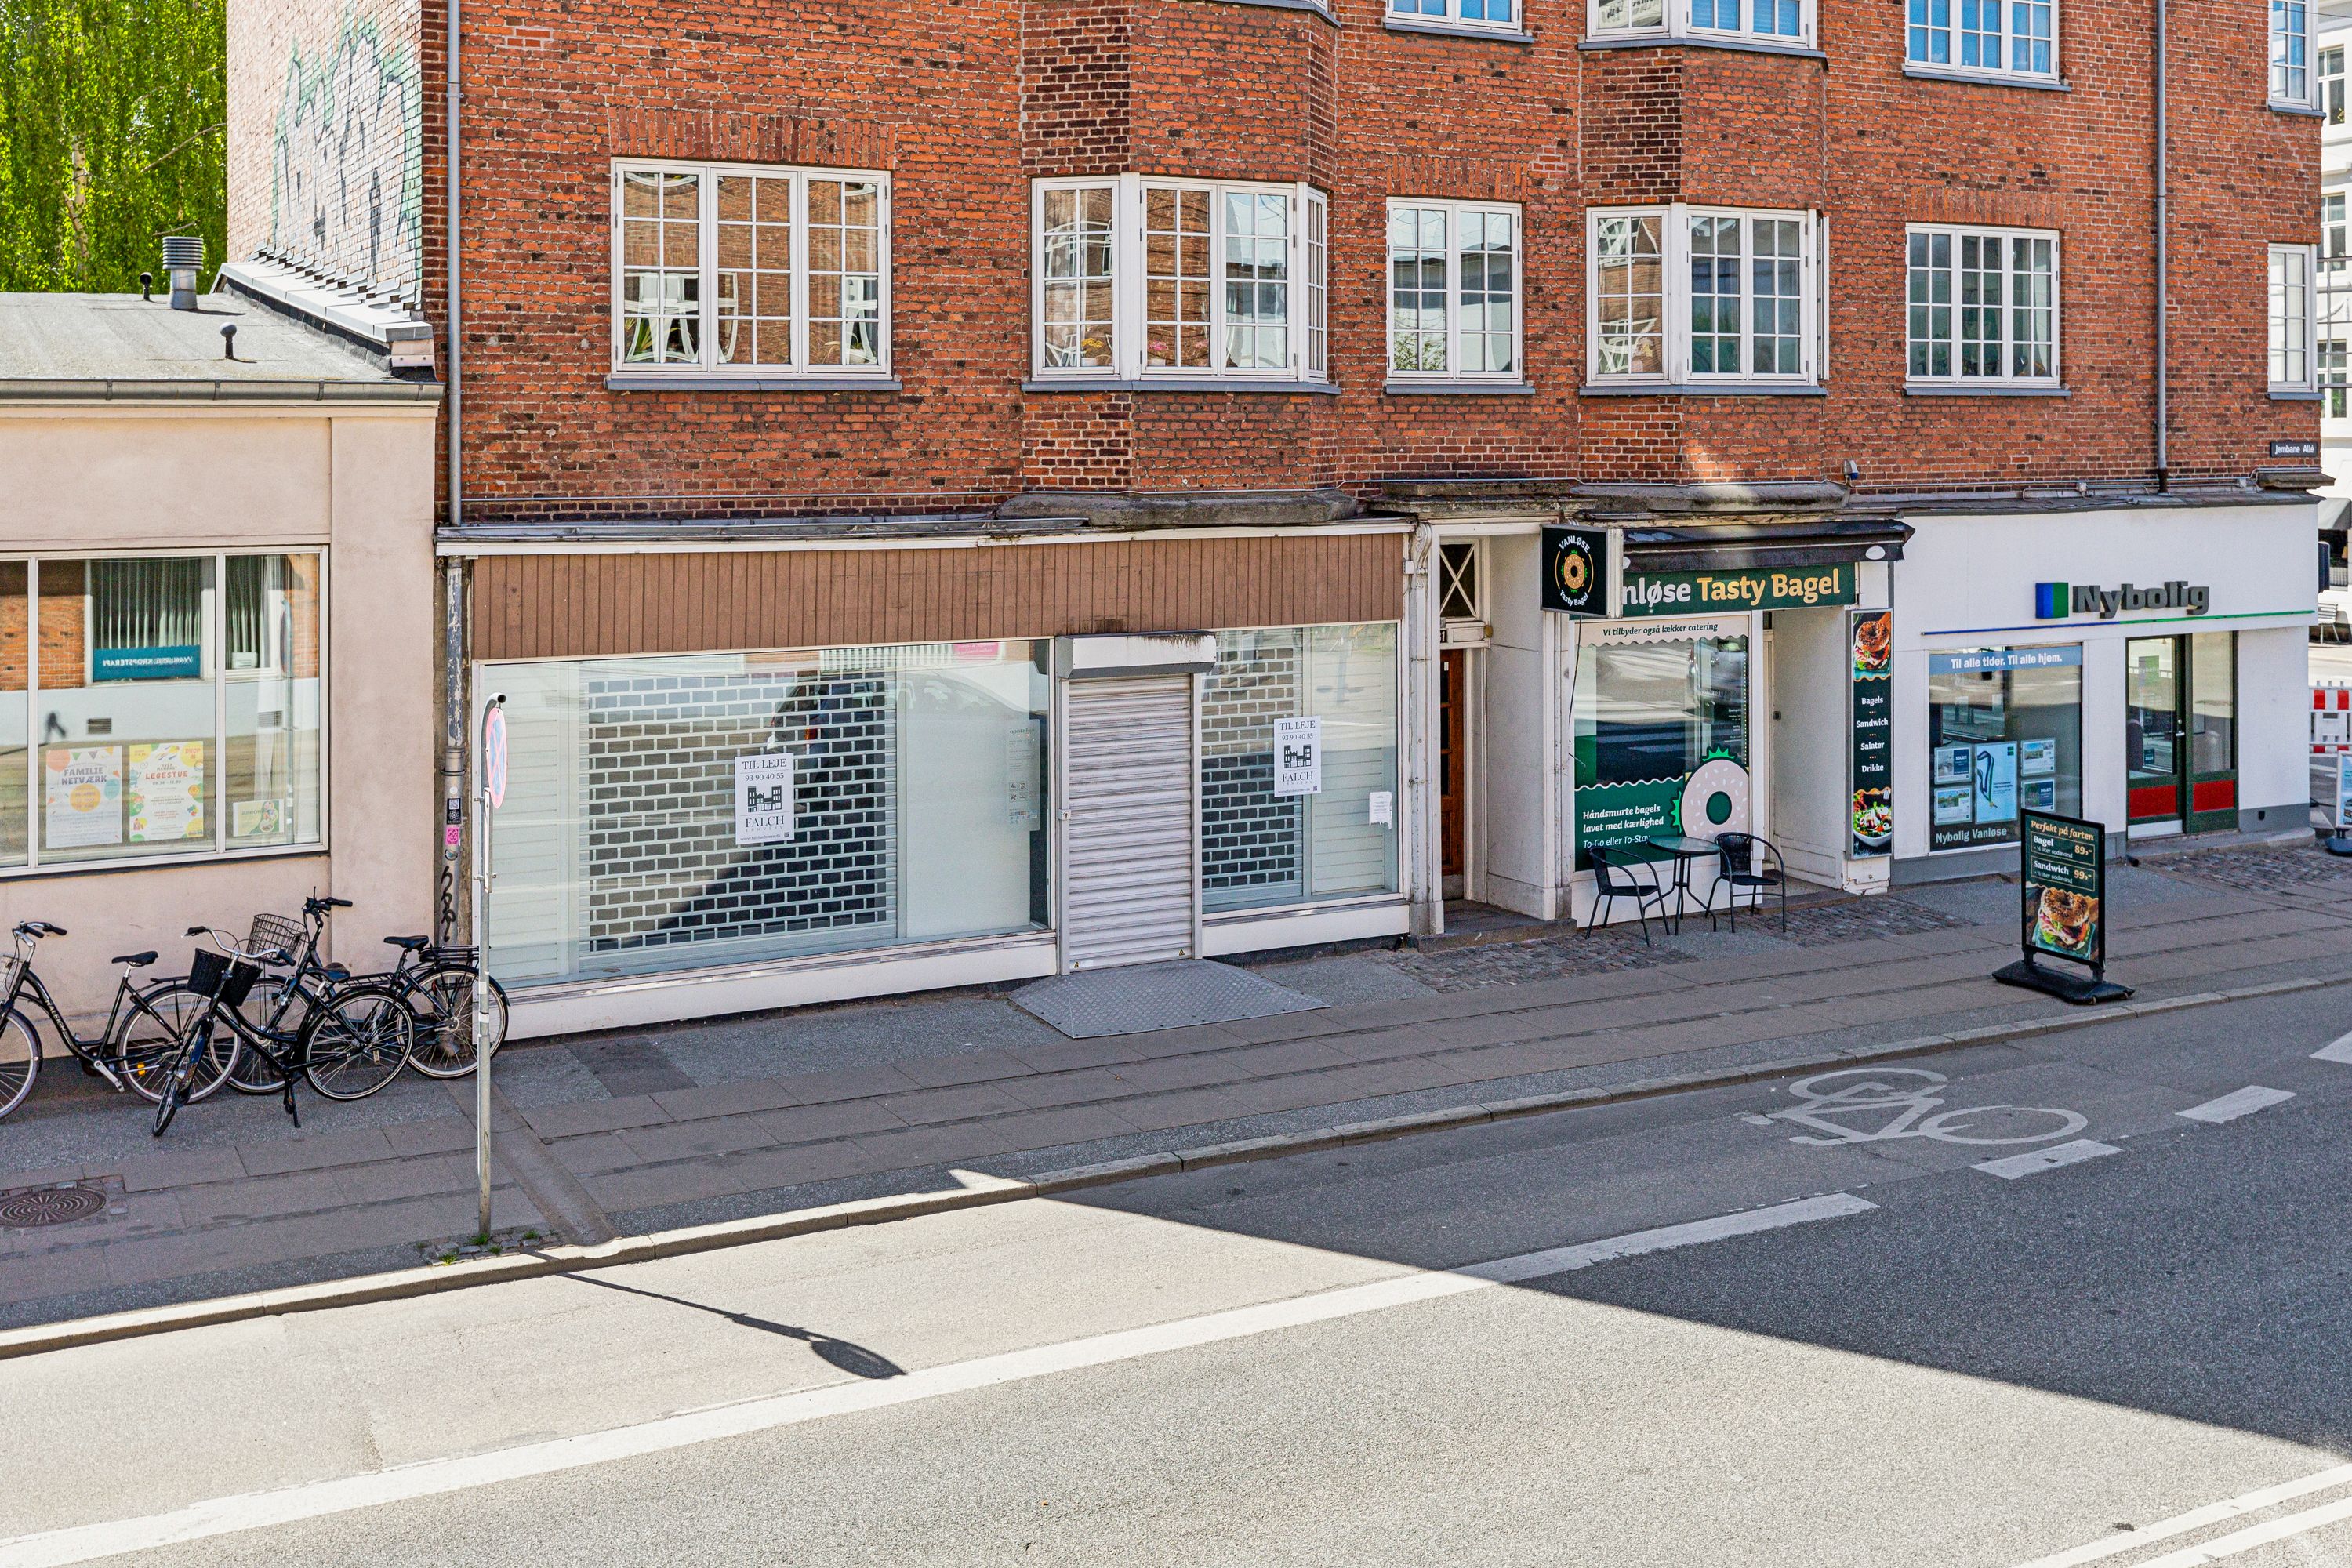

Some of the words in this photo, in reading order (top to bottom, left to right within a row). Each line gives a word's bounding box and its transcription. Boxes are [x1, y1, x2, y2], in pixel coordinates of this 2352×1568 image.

[2303, 444, 2314, 453] Allé
[1559, 535, 1590, 554] VANLØSE
[1623, 577, 1690, 608] nløse
[1697, 575, 1766, 606] Tasty
[1772, 568, 1841, 604] Bagel
[1560, 590, 1573, 607] Tasty
[1574, 592, 1588, 605] Bagel
[2073, 581, 2209, 619] Nybolig
[1613, 627, 1641, 637] tilbyder
[1643, 625, 1661, 636] også
[1688, 622, 1718, 632] catering
[1951, 659, 1962, 669] Til
[1964, 658, 1980, 668] alle
[1982, 657, 2005, 666] tider.
[2007, 655, 2018, 665] Til
[2020, 654, 2037, 665] alle
[2038, 652, 2062, 665] hjem.
[1861, 696, 1883, 706] Bagels
[1295, 720, 1316, 729] LEJE
[1857, 718, 1888, 728] Sandwich
[742, 760, 759, 770] TIL
[762, 759, 787, 768] LEJE
[1861, 764, 1884, 772] Drikke
[64, 767, 103, 776] FAMILIE
[1283, 771, 1314, 782] FALCH
[62, 775, 107, 785] NETVÆRK
[1583, 808, 1633, 819] Håndsmurte
[1635, 804, 1661, 815] bagels
[746, 815, 784, 828] FALCH
[1583, 824, 1603, 833] lavet
[1606, 820, 1623, 830] med
[1624, 816, 1664, 829] kærlighed
[1936, 830, 1969, 845] Nybolig
[1972, 827, 2007, 839] Vanløse
[2031, 820, 2057, 833] Perfekt
[2059, 826, 2068, 836] på
[2069, 828, 2094, 840] farten
[1584, 839, 1604, 848] To-Go
[1606, 837, 1622, 845] eller
[2034, 836, 2053, 847] Bagel
[2074, 845, 2092, 855] 89,-
[2034, 861, 2069, 875] Sandwich
[2074, 870, 2092, 880] 99,-
[45, 1000, 66, 1032] RALEIGH
